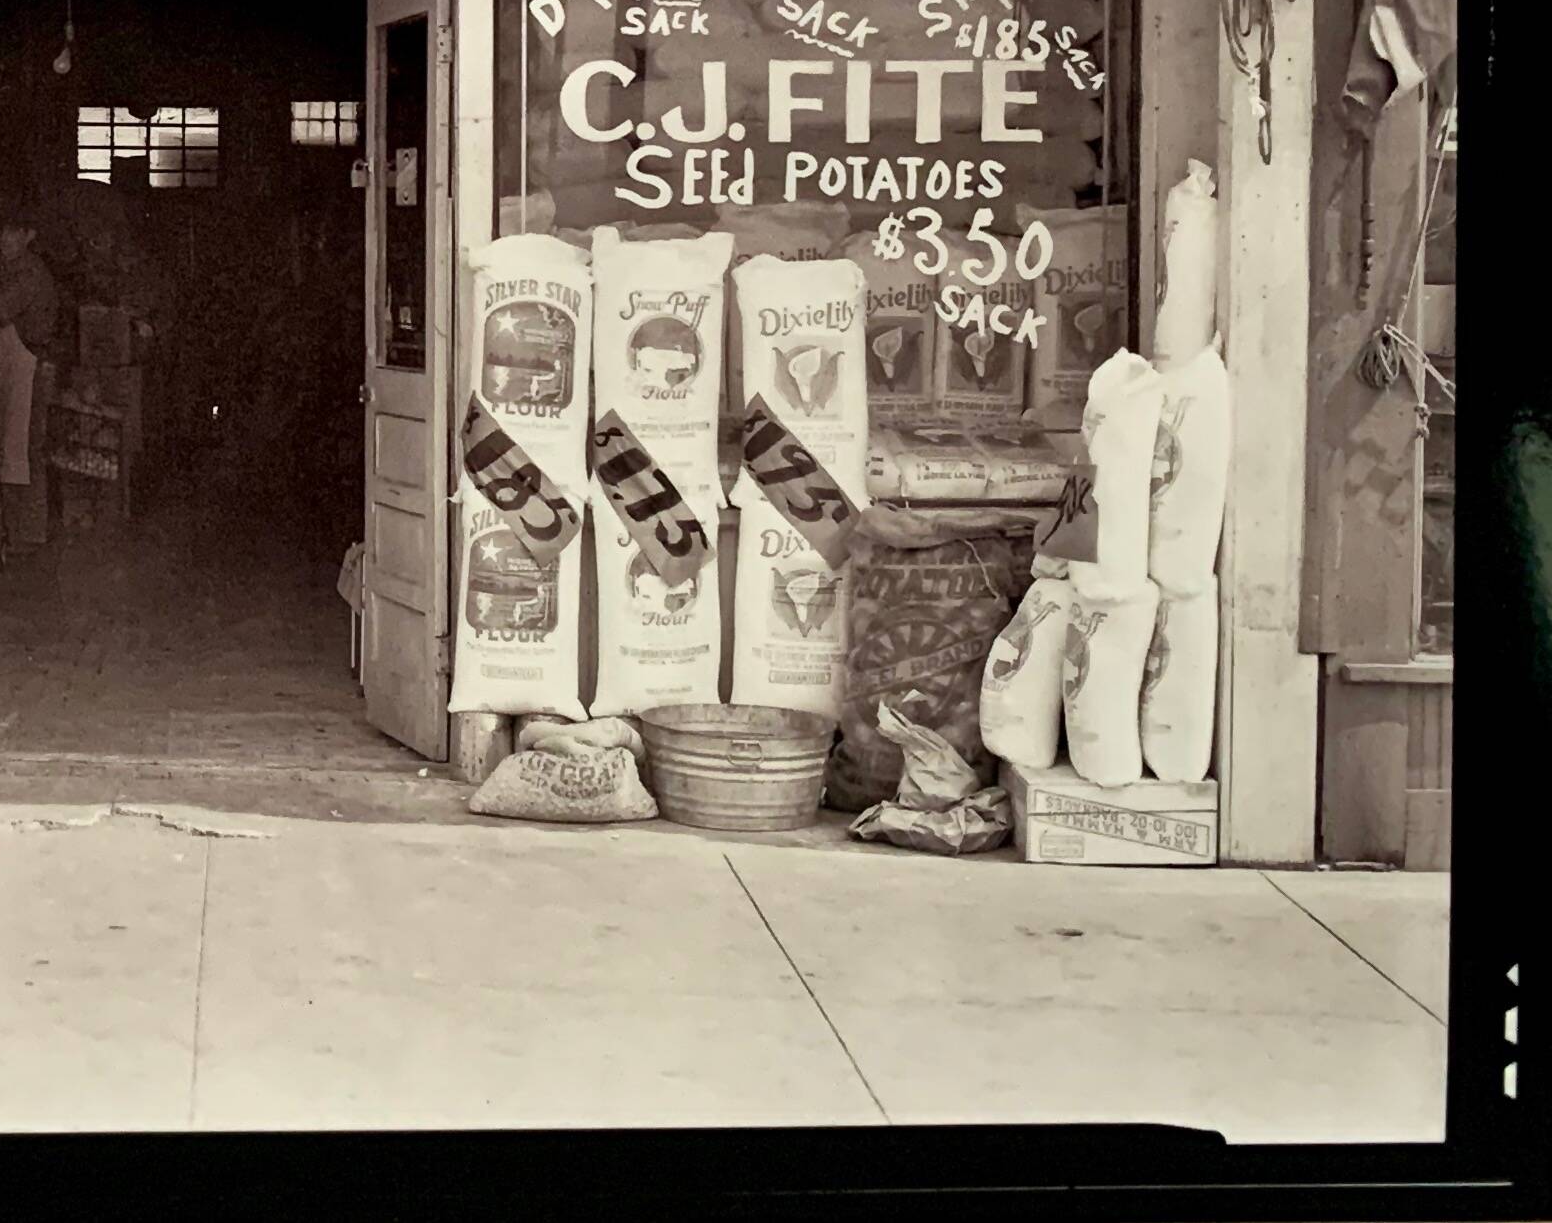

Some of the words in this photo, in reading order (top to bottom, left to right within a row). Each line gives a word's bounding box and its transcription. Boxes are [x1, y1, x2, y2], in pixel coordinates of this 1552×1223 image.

[620, 5, 710, 37] SACK
[767, 59, 1047, 144] FITE
[784, 150, 1006, 203] POTATOES
[485, 278, 539, 311] SILVER
[545, 281, 582, 317] STAR
[934, 284, 1048, 349] SACK
[641, 385, 688, 401] Flour
[491, 402, 562, 419] FLOUR
[641, 610, 691, 627] Flour
[475, 628, 547, 644] FLOUR
